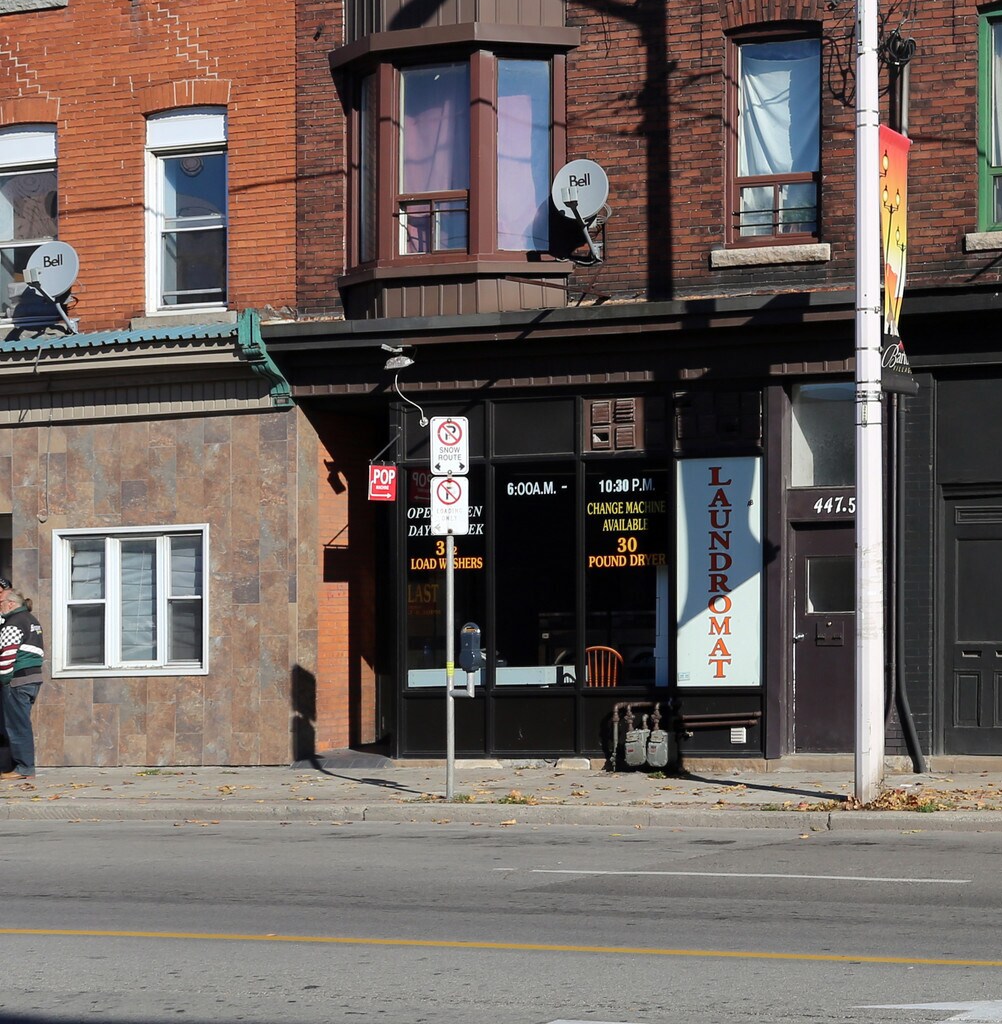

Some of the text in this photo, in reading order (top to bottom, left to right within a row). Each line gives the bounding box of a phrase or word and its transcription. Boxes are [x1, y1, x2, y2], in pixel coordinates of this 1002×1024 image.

[569, 173, 591, 187] Bell
[43, 254, 63, 268] Bell
[438, 453, 462, 461] ROUTE
[439, 446, 461, 454] SNOW
[373, 468, 396, 485] POP
[598, 478, 656, 493] 10:30 P.M.
[586, 500, 667, 515] CHANGE MACHINE
[813, 496, 856, 514] 447.5
[407, 507, 432, 519] OPE
[408, 524, 433, 537] DAY
[602, 518, 649, 532] AVAILABLE
[617, 536, 638, 553] 30
[410, 557, 483, 570] LOAD WSHERS
[588, 553, 667, 568] POUND DRYER
[707, 466, 733, 679] LAUNDROMAT
